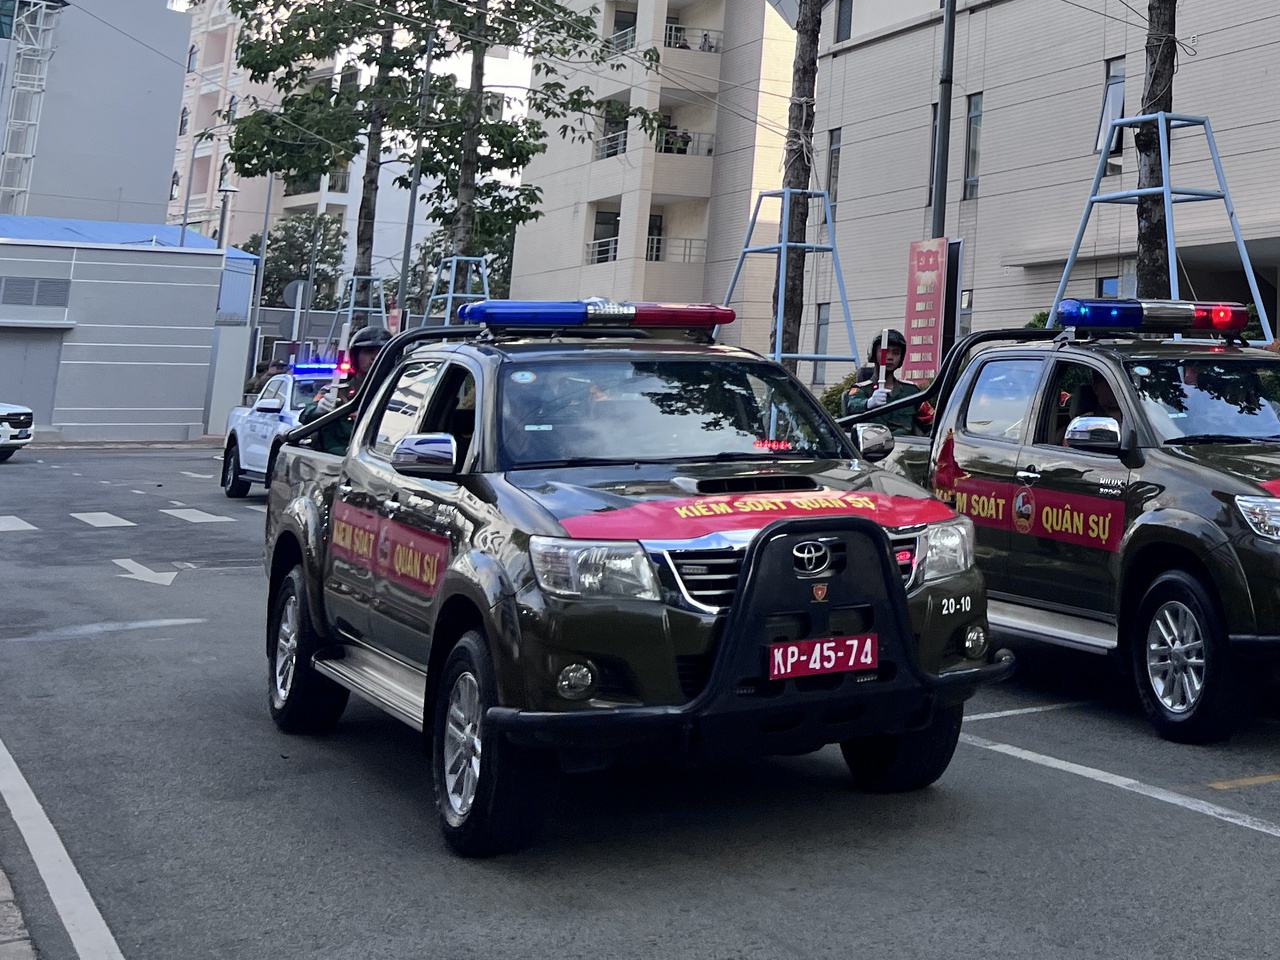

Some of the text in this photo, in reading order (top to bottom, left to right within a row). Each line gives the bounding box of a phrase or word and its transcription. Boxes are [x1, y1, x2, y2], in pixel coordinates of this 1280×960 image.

[674, 500, 734, 518] KIỂM
[970, 491, 1006, 520] SOÁT
[1041, 503, 1084, 536] QUÂN
[1088, 512, 1112, 545] SỰ
[393, 541, 421, 579] QUÂN
[942, 596, 971, 615] 20-10
[773, 638, 873, 675] KP-45-74
